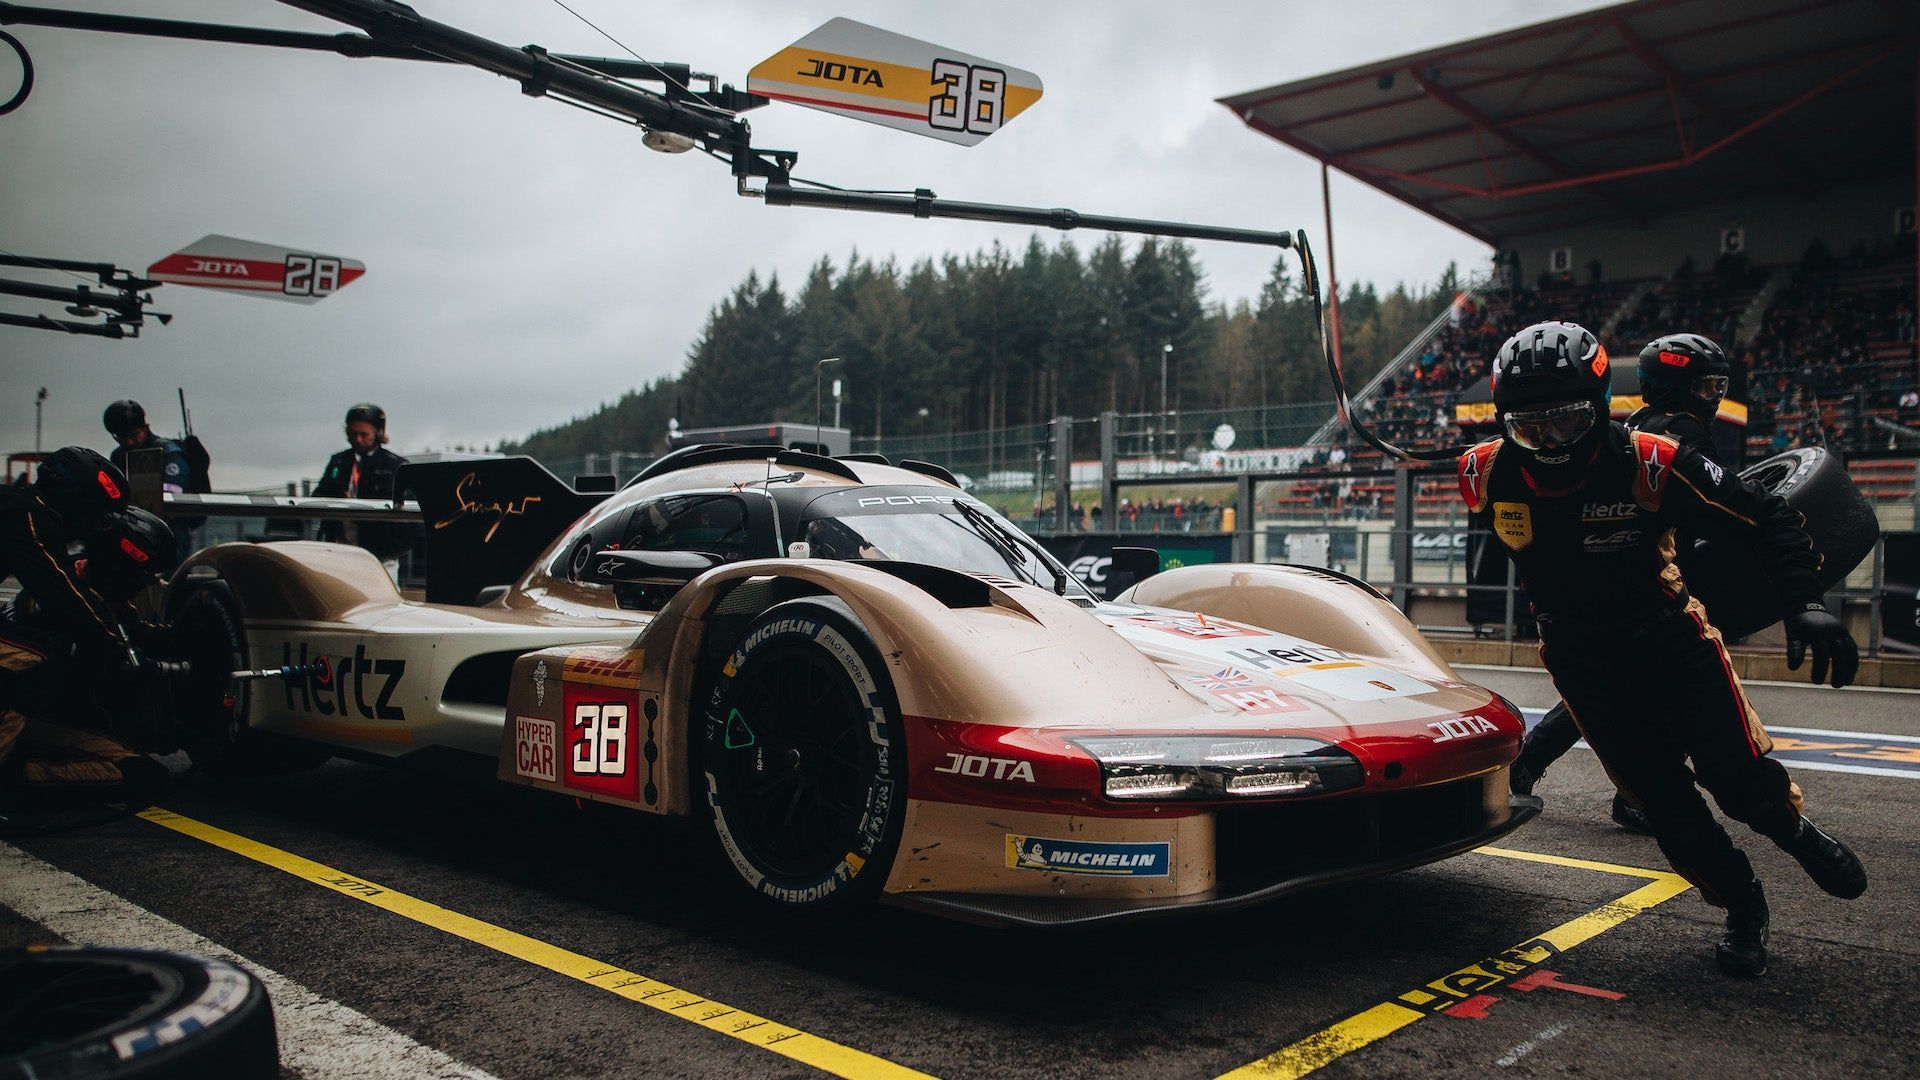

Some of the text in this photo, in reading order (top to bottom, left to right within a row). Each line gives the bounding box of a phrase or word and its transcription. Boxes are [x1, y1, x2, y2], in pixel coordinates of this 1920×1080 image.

[797, 58, 1006, 135] JOTA 38
[1725, 231, 1739, 251] C
[185, 254, 342, 298] JOTA 28
[434, 472, 542, 543] Singer
[1500, 509, 1523, 520] Hertz
[1583, 501, 1638, 518] Hertz
[1069, 555, 1113, 583] EC
[745, 619, 816, 653] MICHELIN
[825, 633, 867, 685] PILOT SPORT
[1220, 689, 1291, 710] HY
[517, 720, 553, 745] HYPER
[572, 702, 629, 777] 38
[1426, 715, 1499, 744] JOTA
[517, 741, 554, 777] CAR
[934, 752, 1036, 783] JOTA
[1050, 850, 1156, 868] MICHELIN
[317, 876, 384, 897] JOTA
[762, 876, 837, 903] MICHELIN
